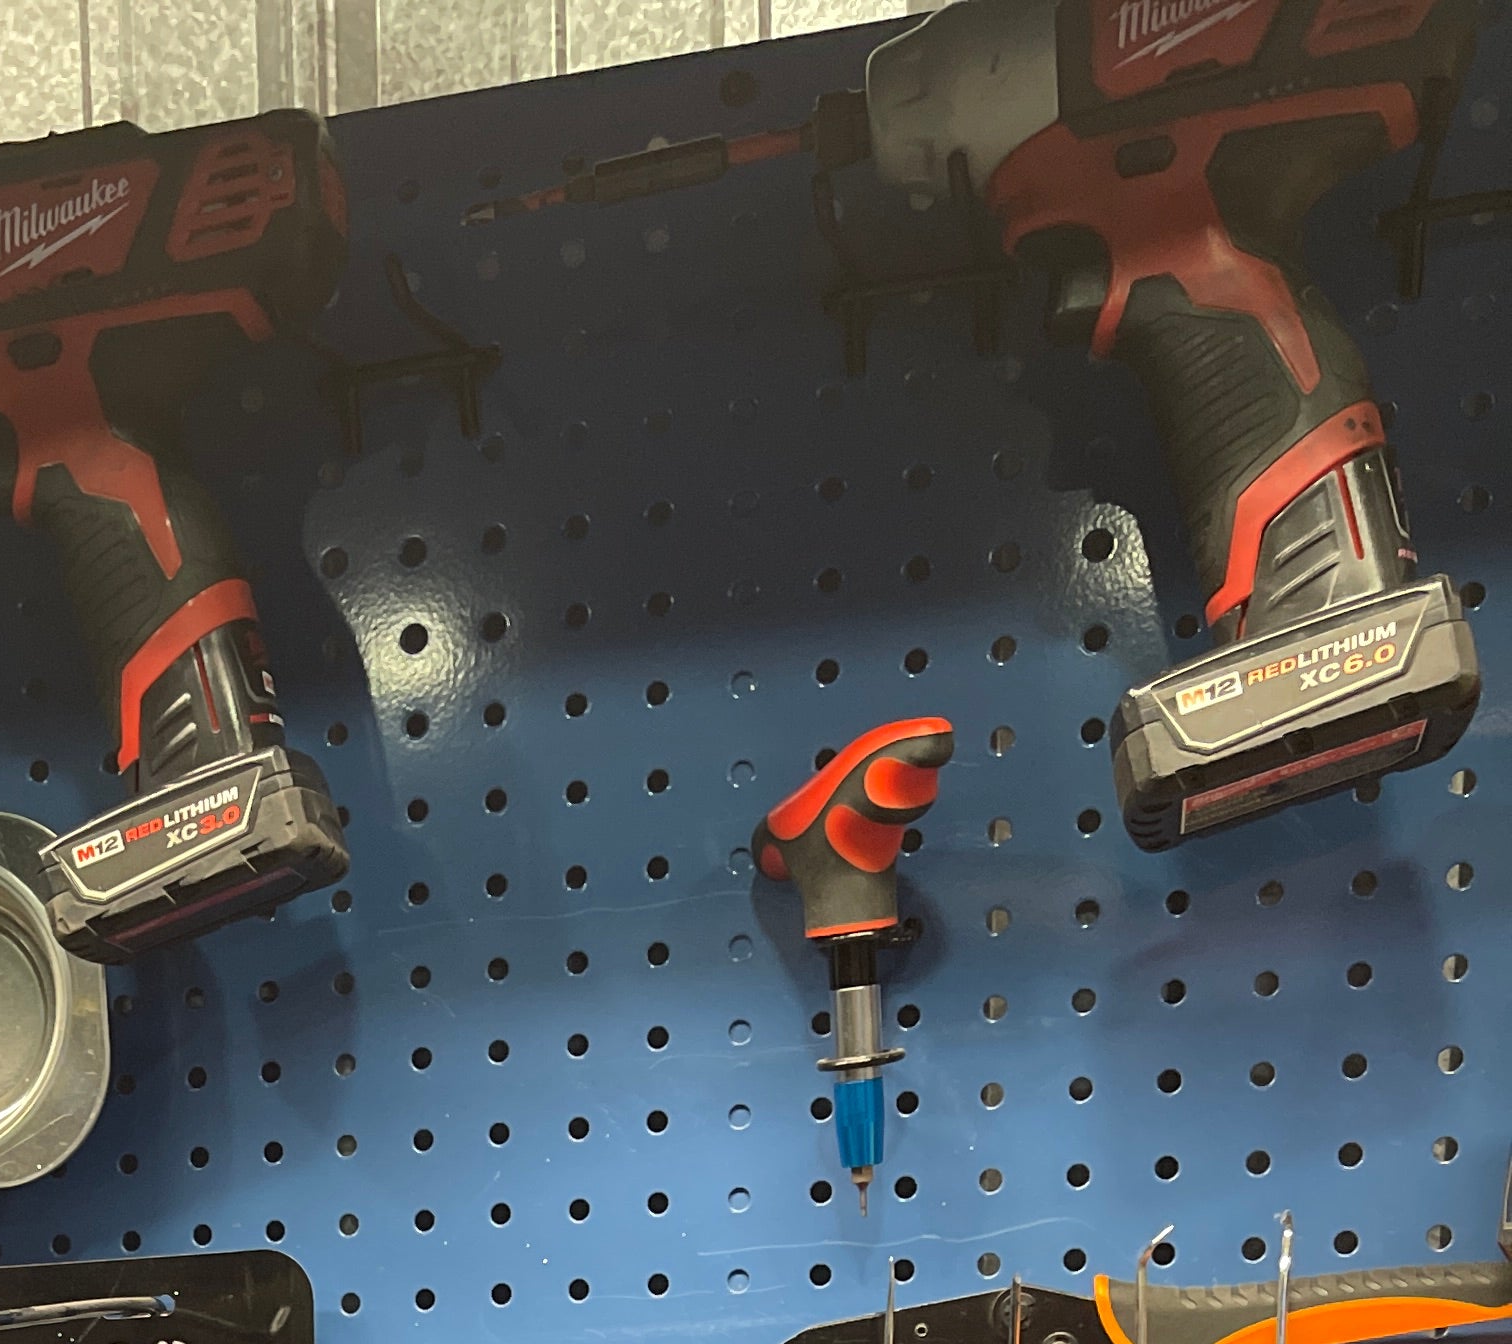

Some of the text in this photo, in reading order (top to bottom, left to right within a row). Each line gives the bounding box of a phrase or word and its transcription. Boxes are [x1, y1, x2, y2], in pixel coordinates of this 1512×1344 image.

[1181, 621, 1398, 710] M12 REDLITHIUM
[1299, 644, 1397, 692] XC6.0
[76, 786, 239, 863] M12 REDLITHIUM
[166, 804, 241, 849] XC3.0
